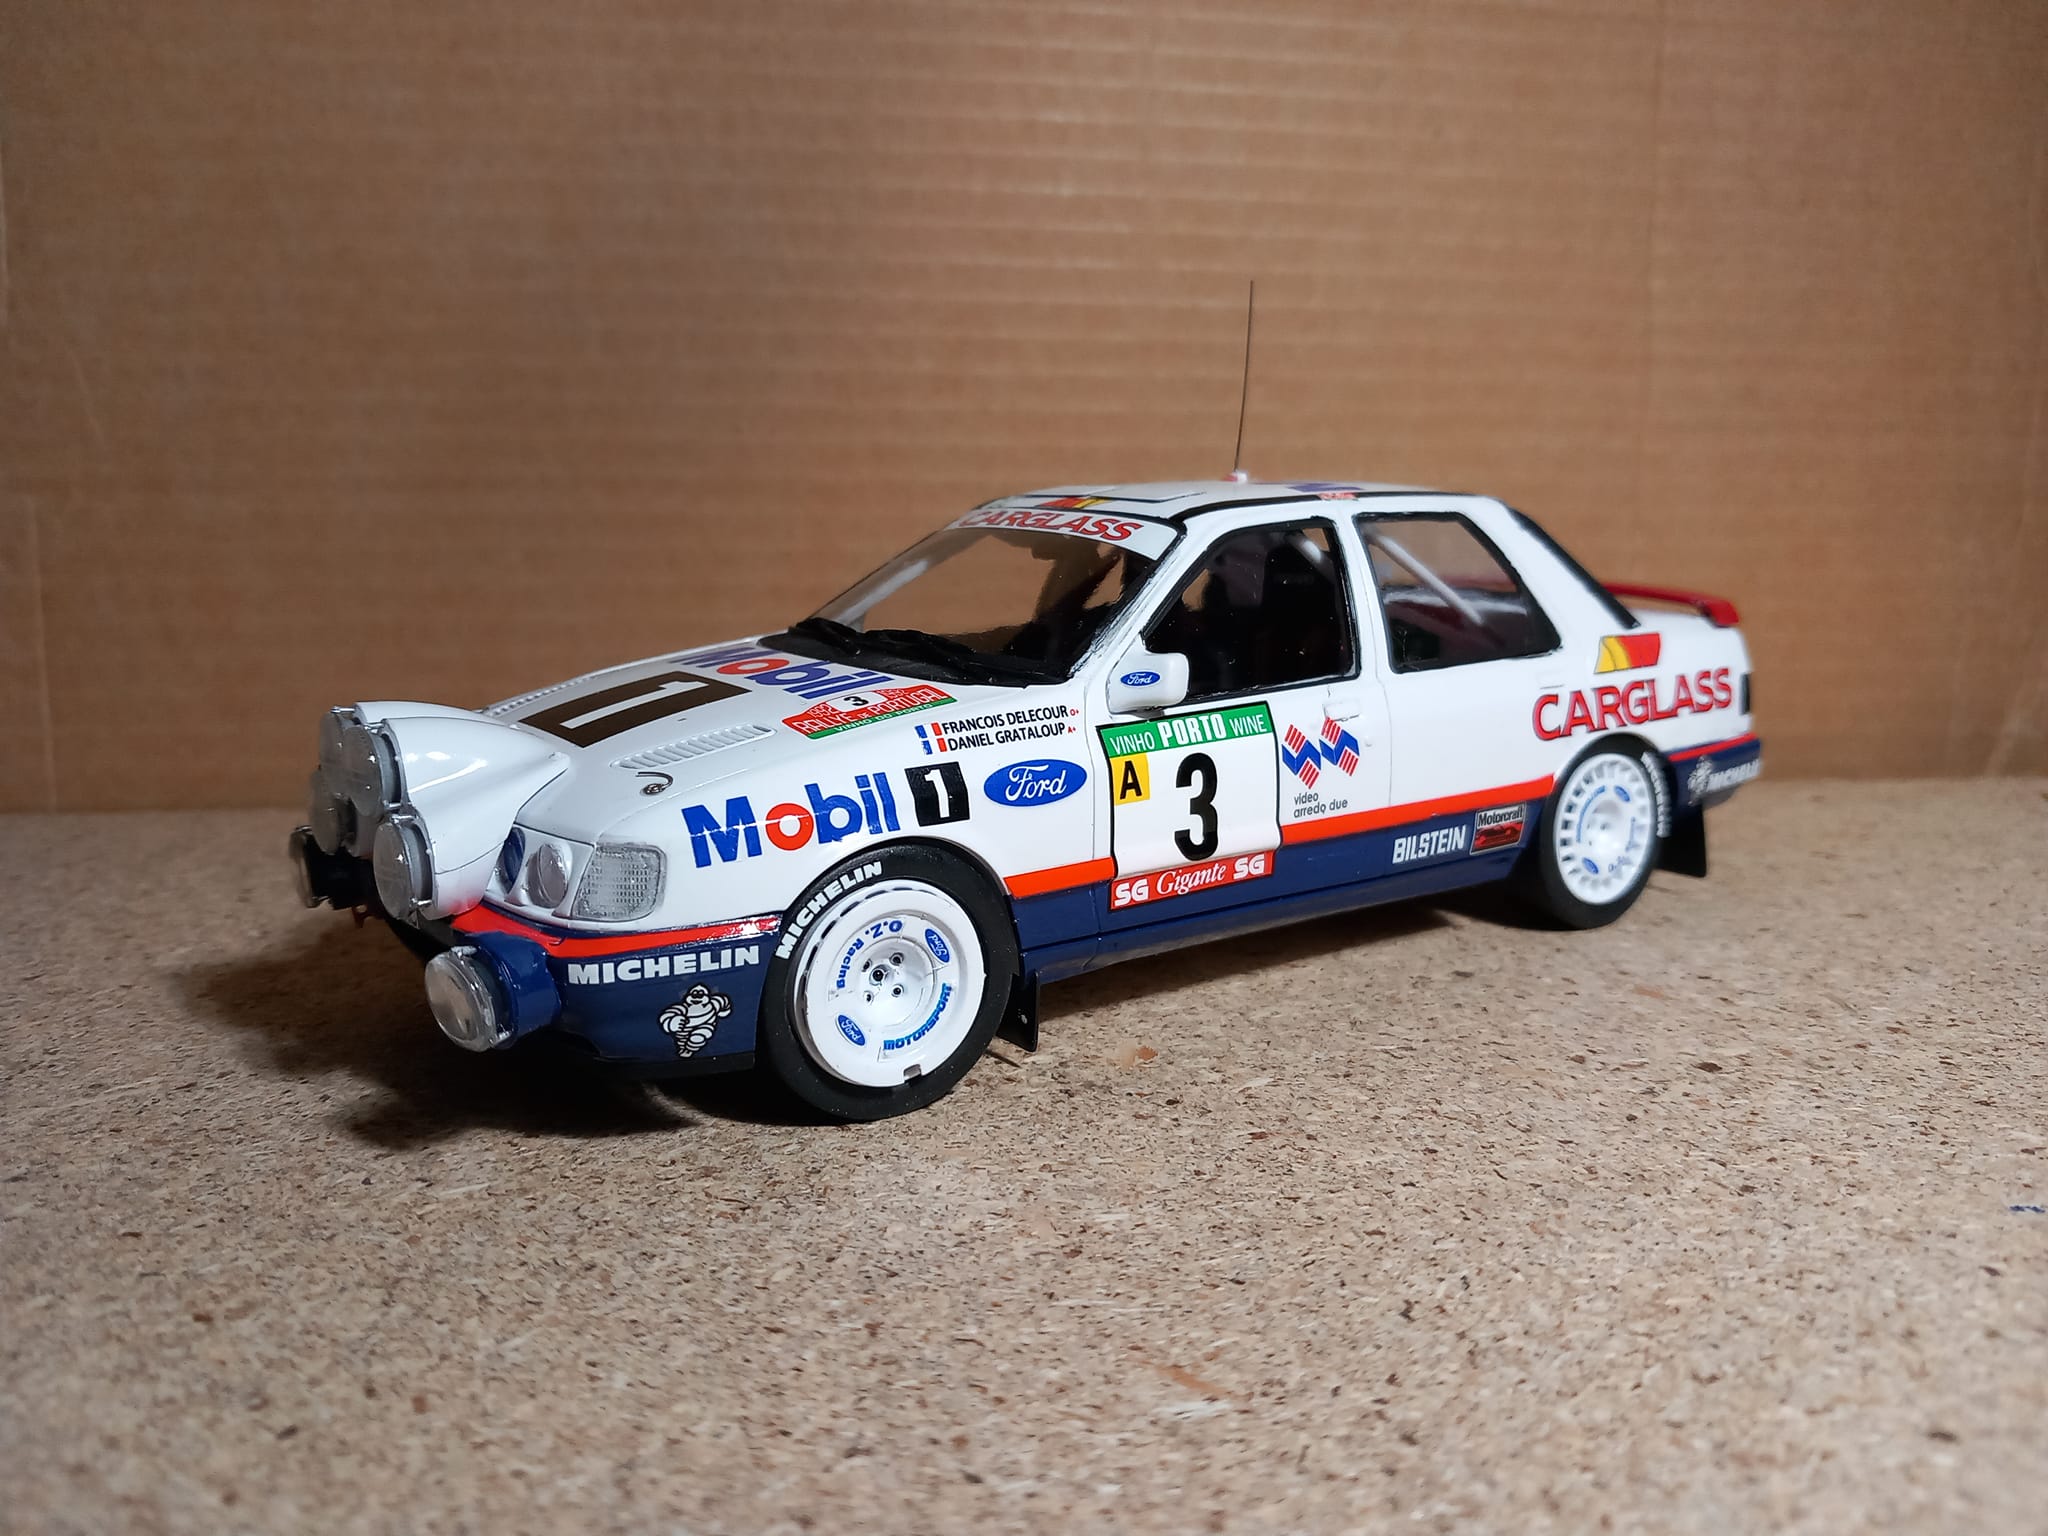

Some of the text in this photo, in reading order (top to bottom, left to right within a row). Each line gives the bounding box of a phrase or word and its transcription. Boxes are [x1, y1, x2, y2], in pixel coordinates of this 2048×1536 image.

[959, 510, 1144, 541] CARGLASS
[668, 646, 895, 700] Mobil
[791, 711, 853, 735] RALLYE
[871, 688, 943, 715] PORTUGAL
[843, 696, 869, 706] 3
[941, 715, 1005, 735] FRANCOIS
[1006, 705, 1069, 725] DELECOUR
[1532, 667, 1732, 741] CARGLASS
[947, 734, 995, 752] DANIEL
[995, 722, 1066, 745] GRATALOUP
[1110, 713, 1268, 755] VINHO PORTO WINE
[1005, 764, 1067, 801] Ford
[1119, 760, 1142, 800] A
[1293, 791, 1319, 806] video
[680, 768, 950, 868] Mobil 1
[1174, 752, 1219, 861] 3
[1293, 798, 1349, 818] arredo due
[1476, 806, 1524, 828] Motorcraft
[1392, 824, 1468, 864] BILSTEIN
[1114, 853, 1266, 907] SG Gigante SG
[774, 860, 883, 960] MICHELIN
[567, 944, 760, 986] MICHELIN
[835, 937, 865, 990] Racing
[840, 1017, 861, 1043] Ford
[882, 982, 953, 1051] MOTORSPORT
